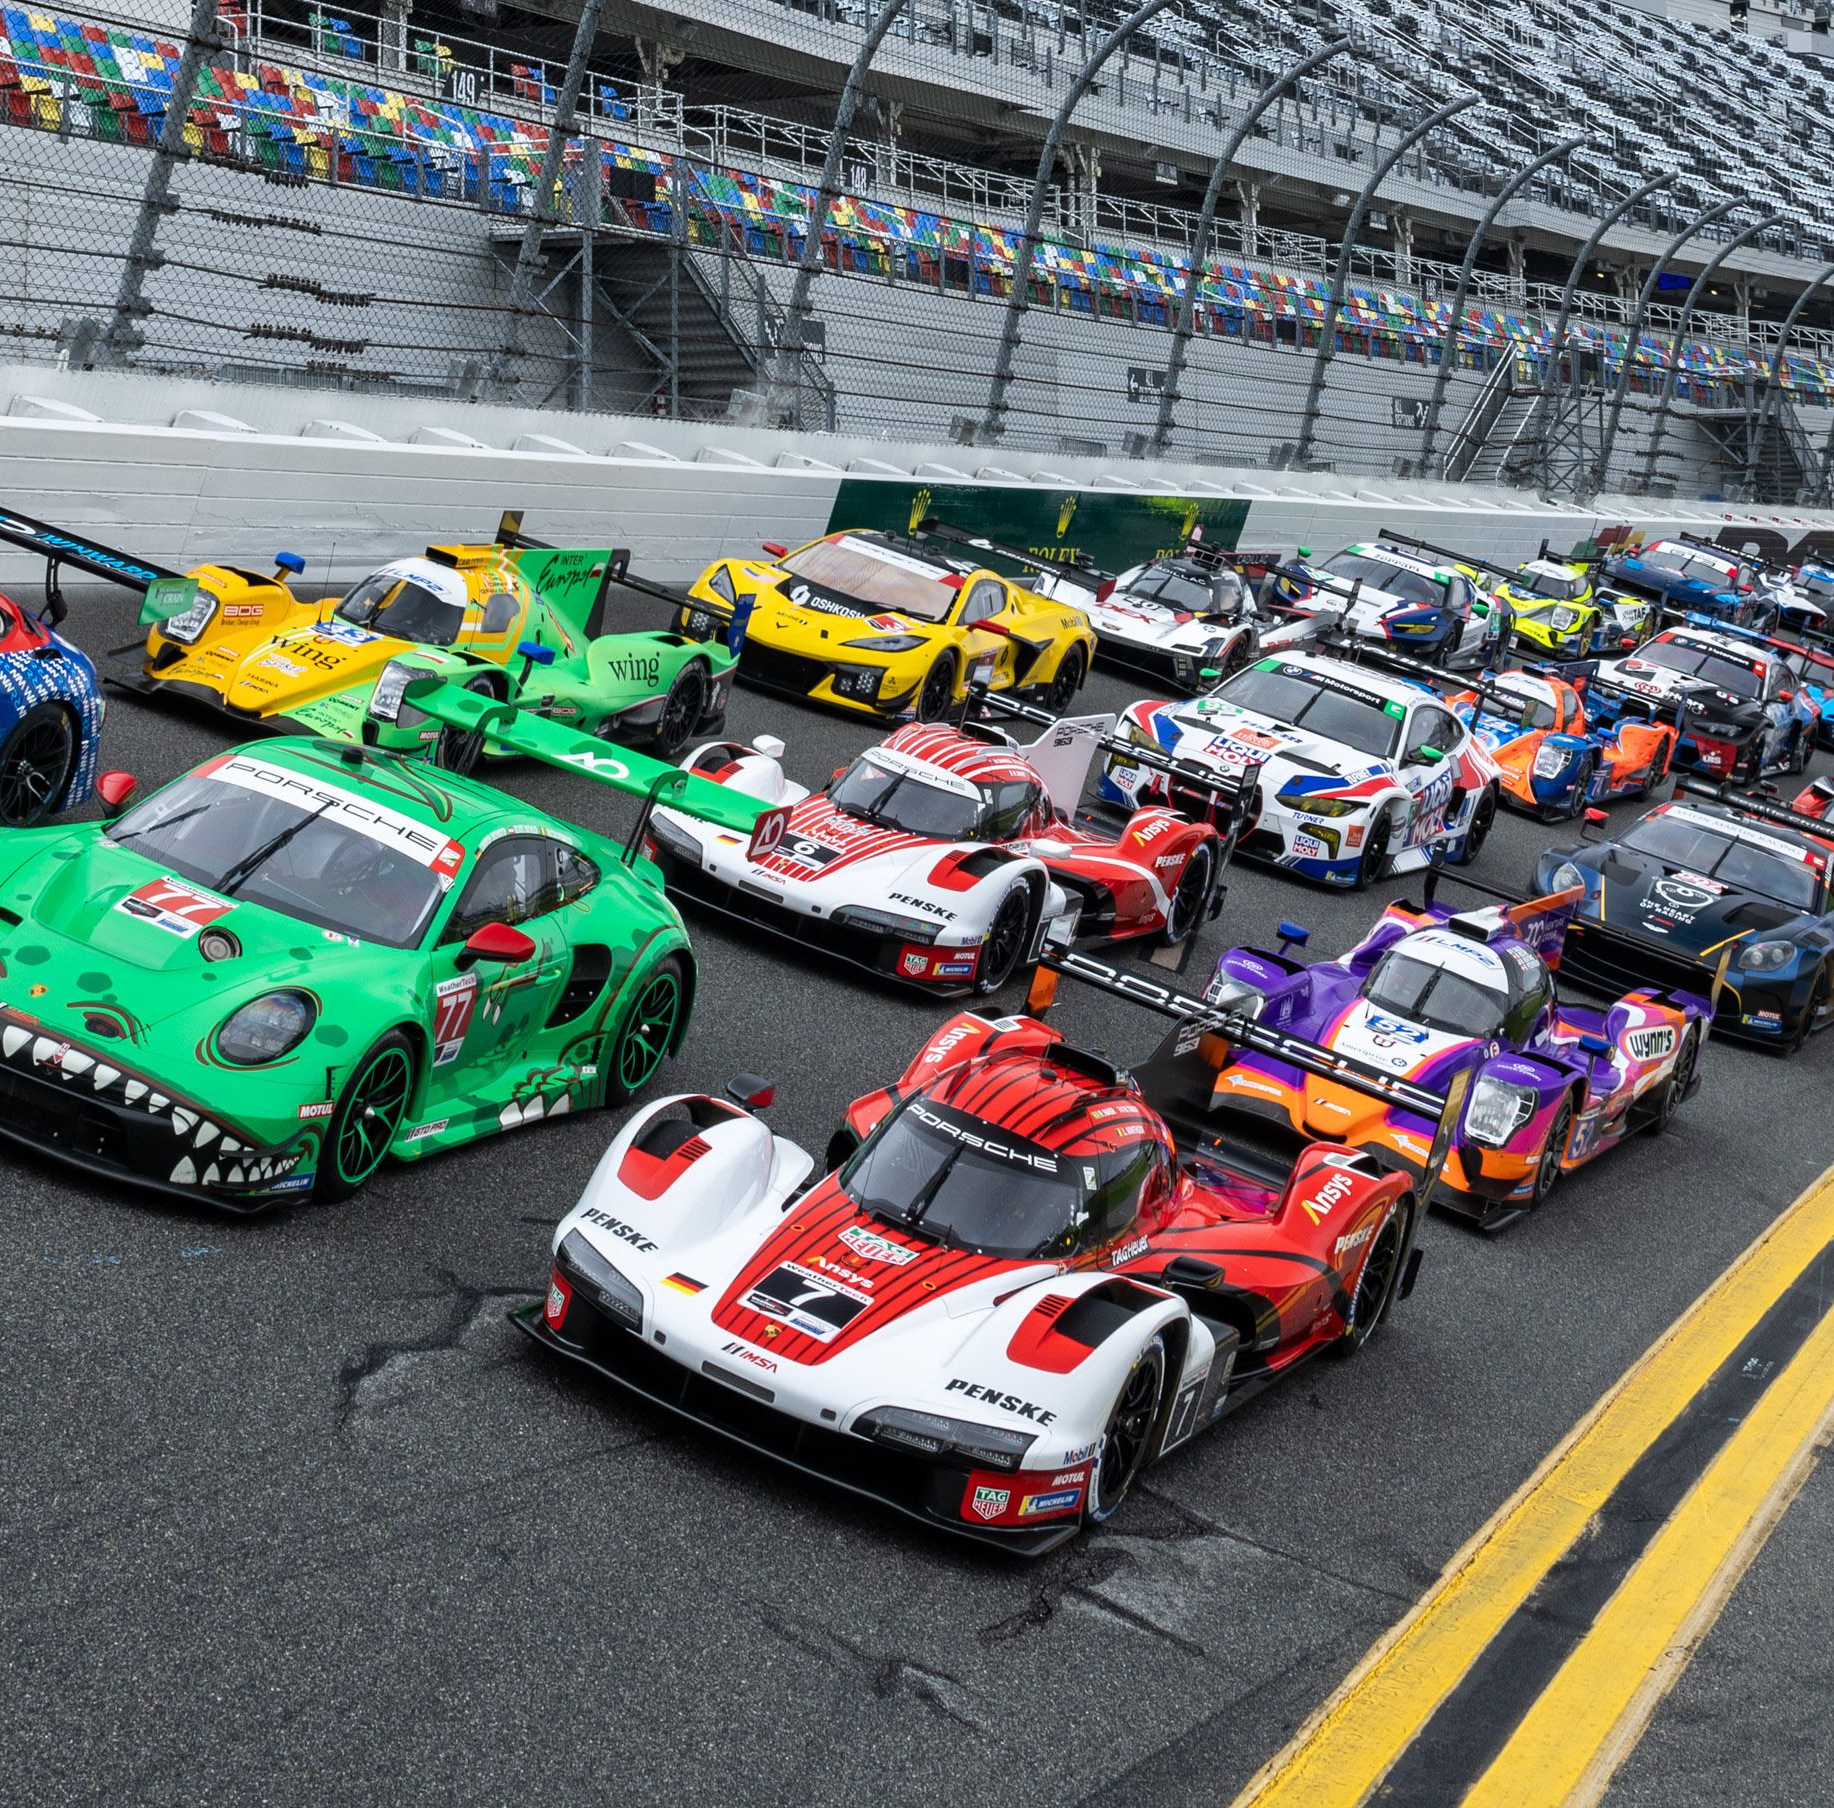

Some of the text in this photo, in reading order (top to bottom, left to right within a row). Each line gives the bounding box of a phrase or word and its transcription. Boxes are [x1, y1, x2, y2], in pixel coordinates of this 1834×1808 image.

[452, 70, 475, 106] 149
[850, 164, 867, 196] 148
[44, 534, 159, 580] WINWARD
[393, 570, 444, 592] LMP2
[810, 596, 866, 620] OSHKOSH
[271, 634, 347, 670] wing
[607, 651, 661, 688] wing
[1325, 678, 1381, 705] Motorsport
[1053, 737, 1072, 747] 963
[1211, 736, 1271, 765] LIQUI
[1204, 743, 1265, 767] MOLY
[870, 750, 966, 791] PORSCHE
[225, 761, 438, 852] PORSCHE
[1292, 811, 1325, 824] TURNER
[1132, 817, 1171, 848] Ansys
[1295, 835, 1320, 848] LIQUI
[794, 840, 815, 855] 6
[1293, 844, 1319, 857] MOLY
[1155, 853, 1186, 868] PENSKE
[763, 873, 786, 886] IMSA
[146, 883, 223, 915] 77
[888, 892, 958, 922] PENSKE
[1642, 898, 1696, 921] THE HEART
[1639, 902, 1692, 925] OF RACING
[907, 954, 927, 965] TAG
[954, 952, 975, 960] MOTUL
[1436, 938, 1496, 966] LMP2
[944, 965, 969, 973] MICHELIN
[439, 975, 476, 993] WeatherTech
[437, 991, 474, 1043] 77
[1758, 1010, 1780, 1020] MOTUL
[925, 1022, 981, 1064] Ansys
[1173, 1037, 1201, 1057] 963
[300, 1104, 333, 1118] MOTUL
[906, 1103, 1058, 1173] PORSCHE
[271, 1178, 308, 1190] MICHELIN
[1301, 1171, 1353, 1226] Ansys
[580, 1207, 659, 1254] PENSKE
[848, 1226, 921, 1260] TAG
[1334, 1223, 1375, 1254] PENSKE
[840, 1231, 907, 1265] HEUER
[786, 1262, 871, 1303] WeatherTech
[806, 1254, 875, 1289] Ansys
[789, 1278, 837, 1307] 7
[739, 1350, 779, 1374] IMSA
[945, 1378, 1057, 1427] PENSKE
[1176, 1389, 1196, 1437] 7
[1063, 1446, 1088, 1466] Mobil
[1052, 1470, 1085, 1487] MOTUL
[979, 1488, 1006, 1501] TAG
[1038, 1494, 1075, 1509] MICHELIN
[974, 1500, 1006, 1518] HEUER
